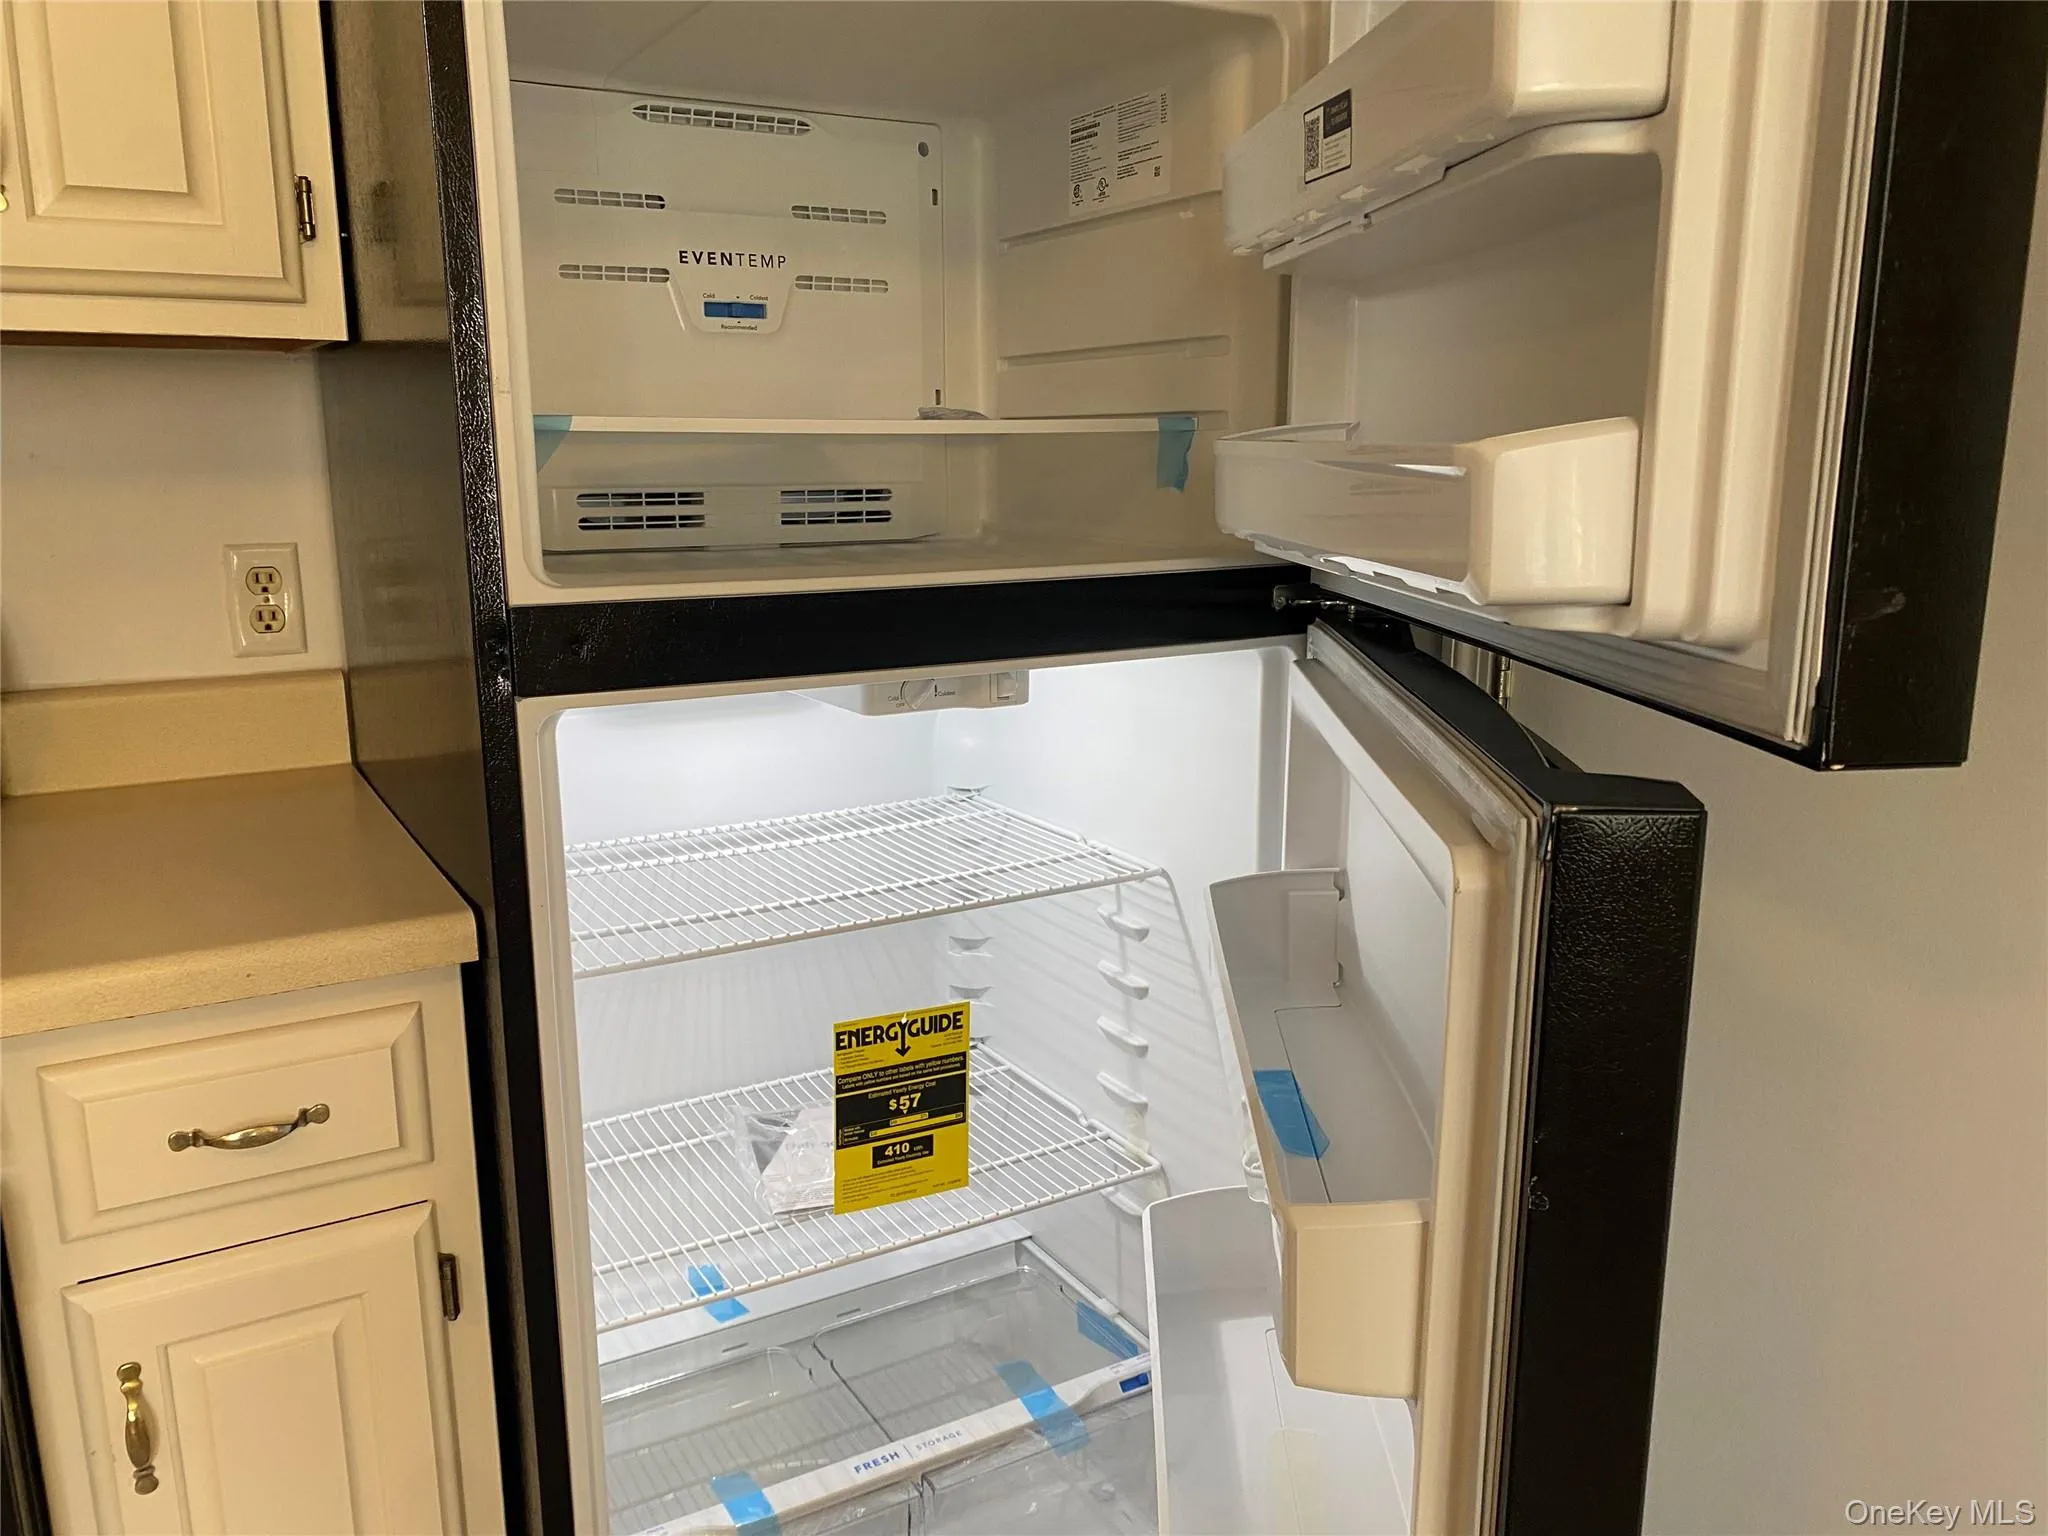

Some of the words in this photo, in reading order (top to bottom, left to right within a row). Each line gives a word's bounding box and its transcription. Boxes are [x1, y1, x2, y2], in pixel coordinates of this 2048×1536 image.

[679, 250, 786, 269] EVENTEMP
[720, 323, 758, 331] Recommended
[835, 1010, 964, 1051] ENERGYGUIDE
[837, 1075, 861, 1085] Compare
[862, 1072, 877, 1080] ONLY
[926, 1060, 941, 1068] yellow
[868, 1089, 891, 1099] Estimated
[908, 1083, 924, 1091] Energy
[888, 1092, 922, 1111] $57
[885, 1142, 909, 1156] 410
[853, 1451, 900, 1474] FRESH
[915, 1429, 962, 1451] STORAGE
